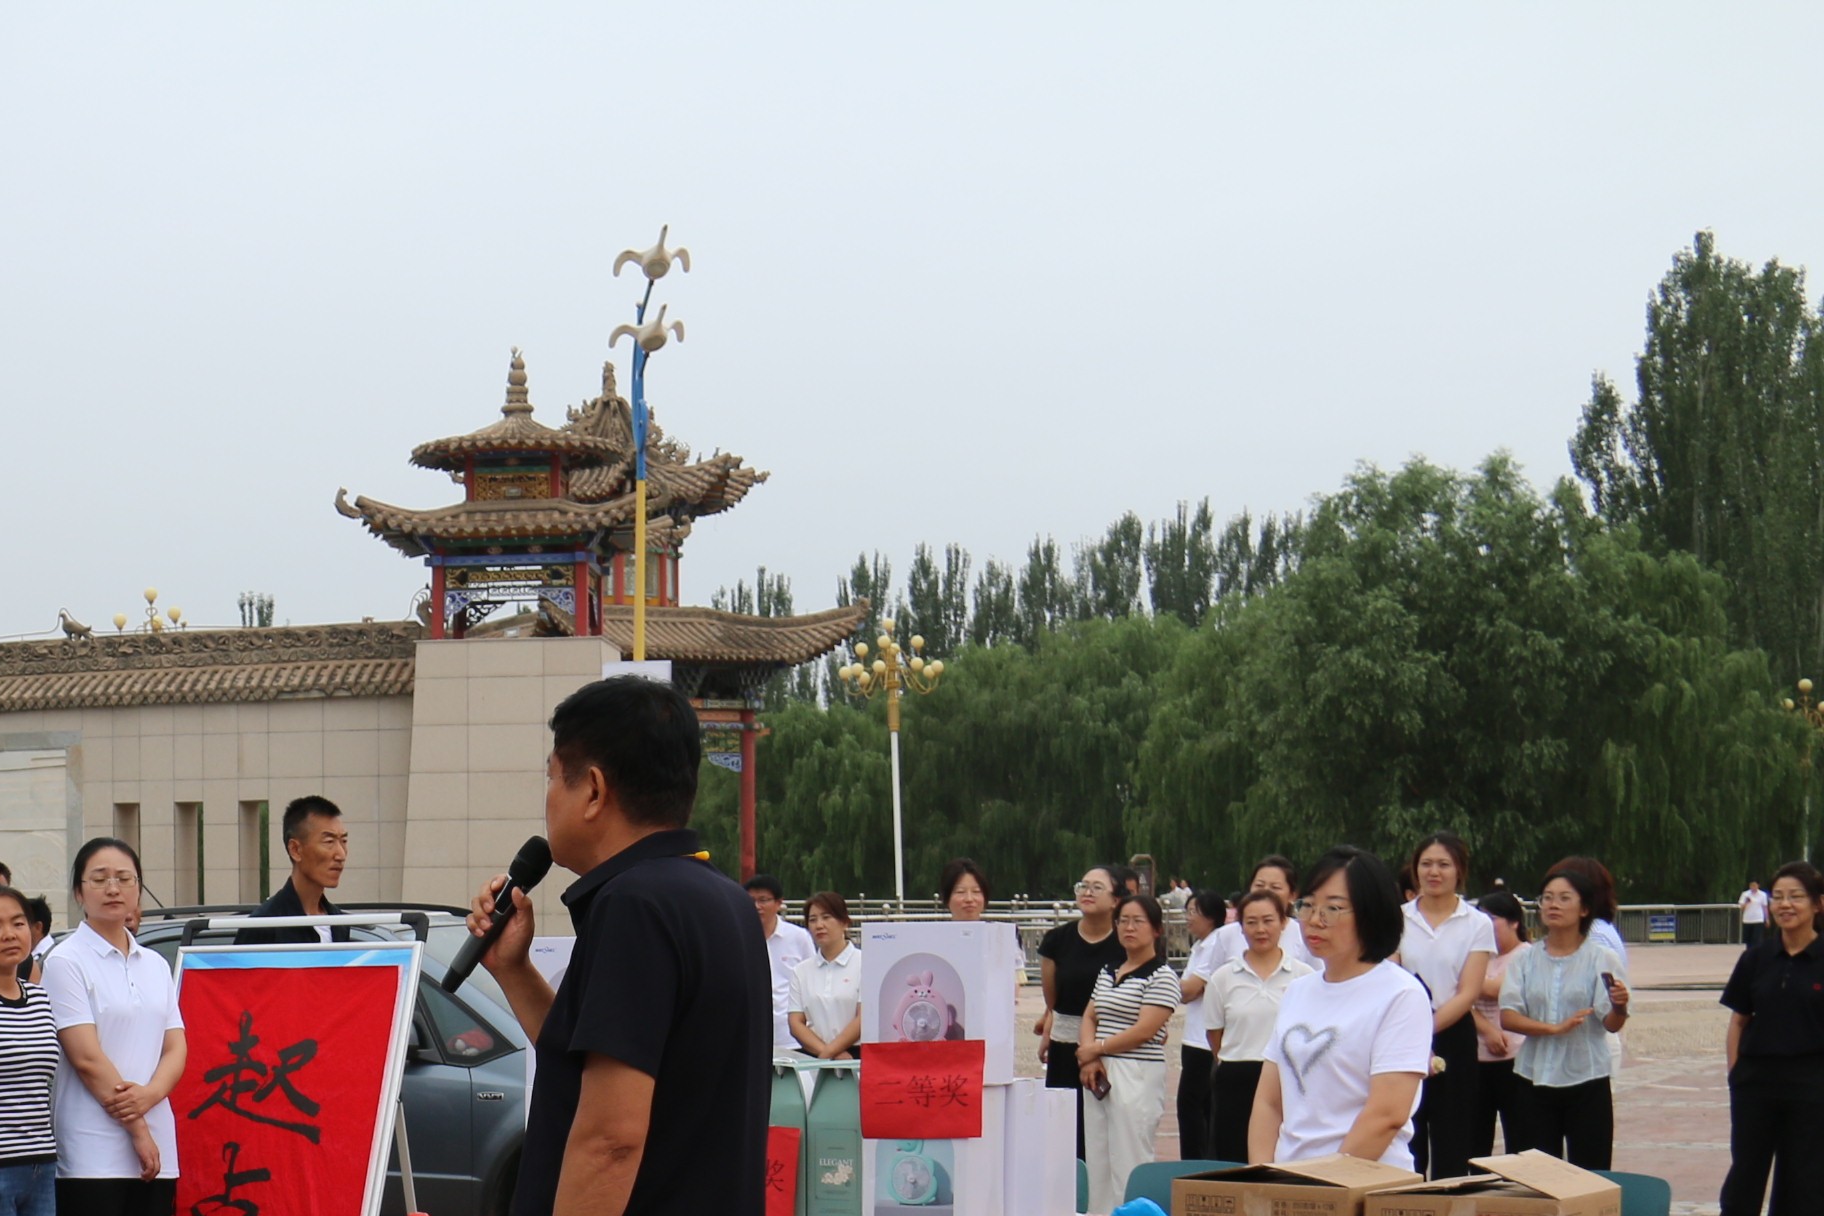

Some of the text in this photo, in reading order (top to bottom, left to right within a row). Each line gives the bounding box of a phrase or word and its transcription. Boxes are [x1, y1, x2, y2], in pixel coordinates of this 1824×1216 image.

[874, 1073, 969, 1108] 二等奖
[818, 1158, 854, 1167] ELEGANT
